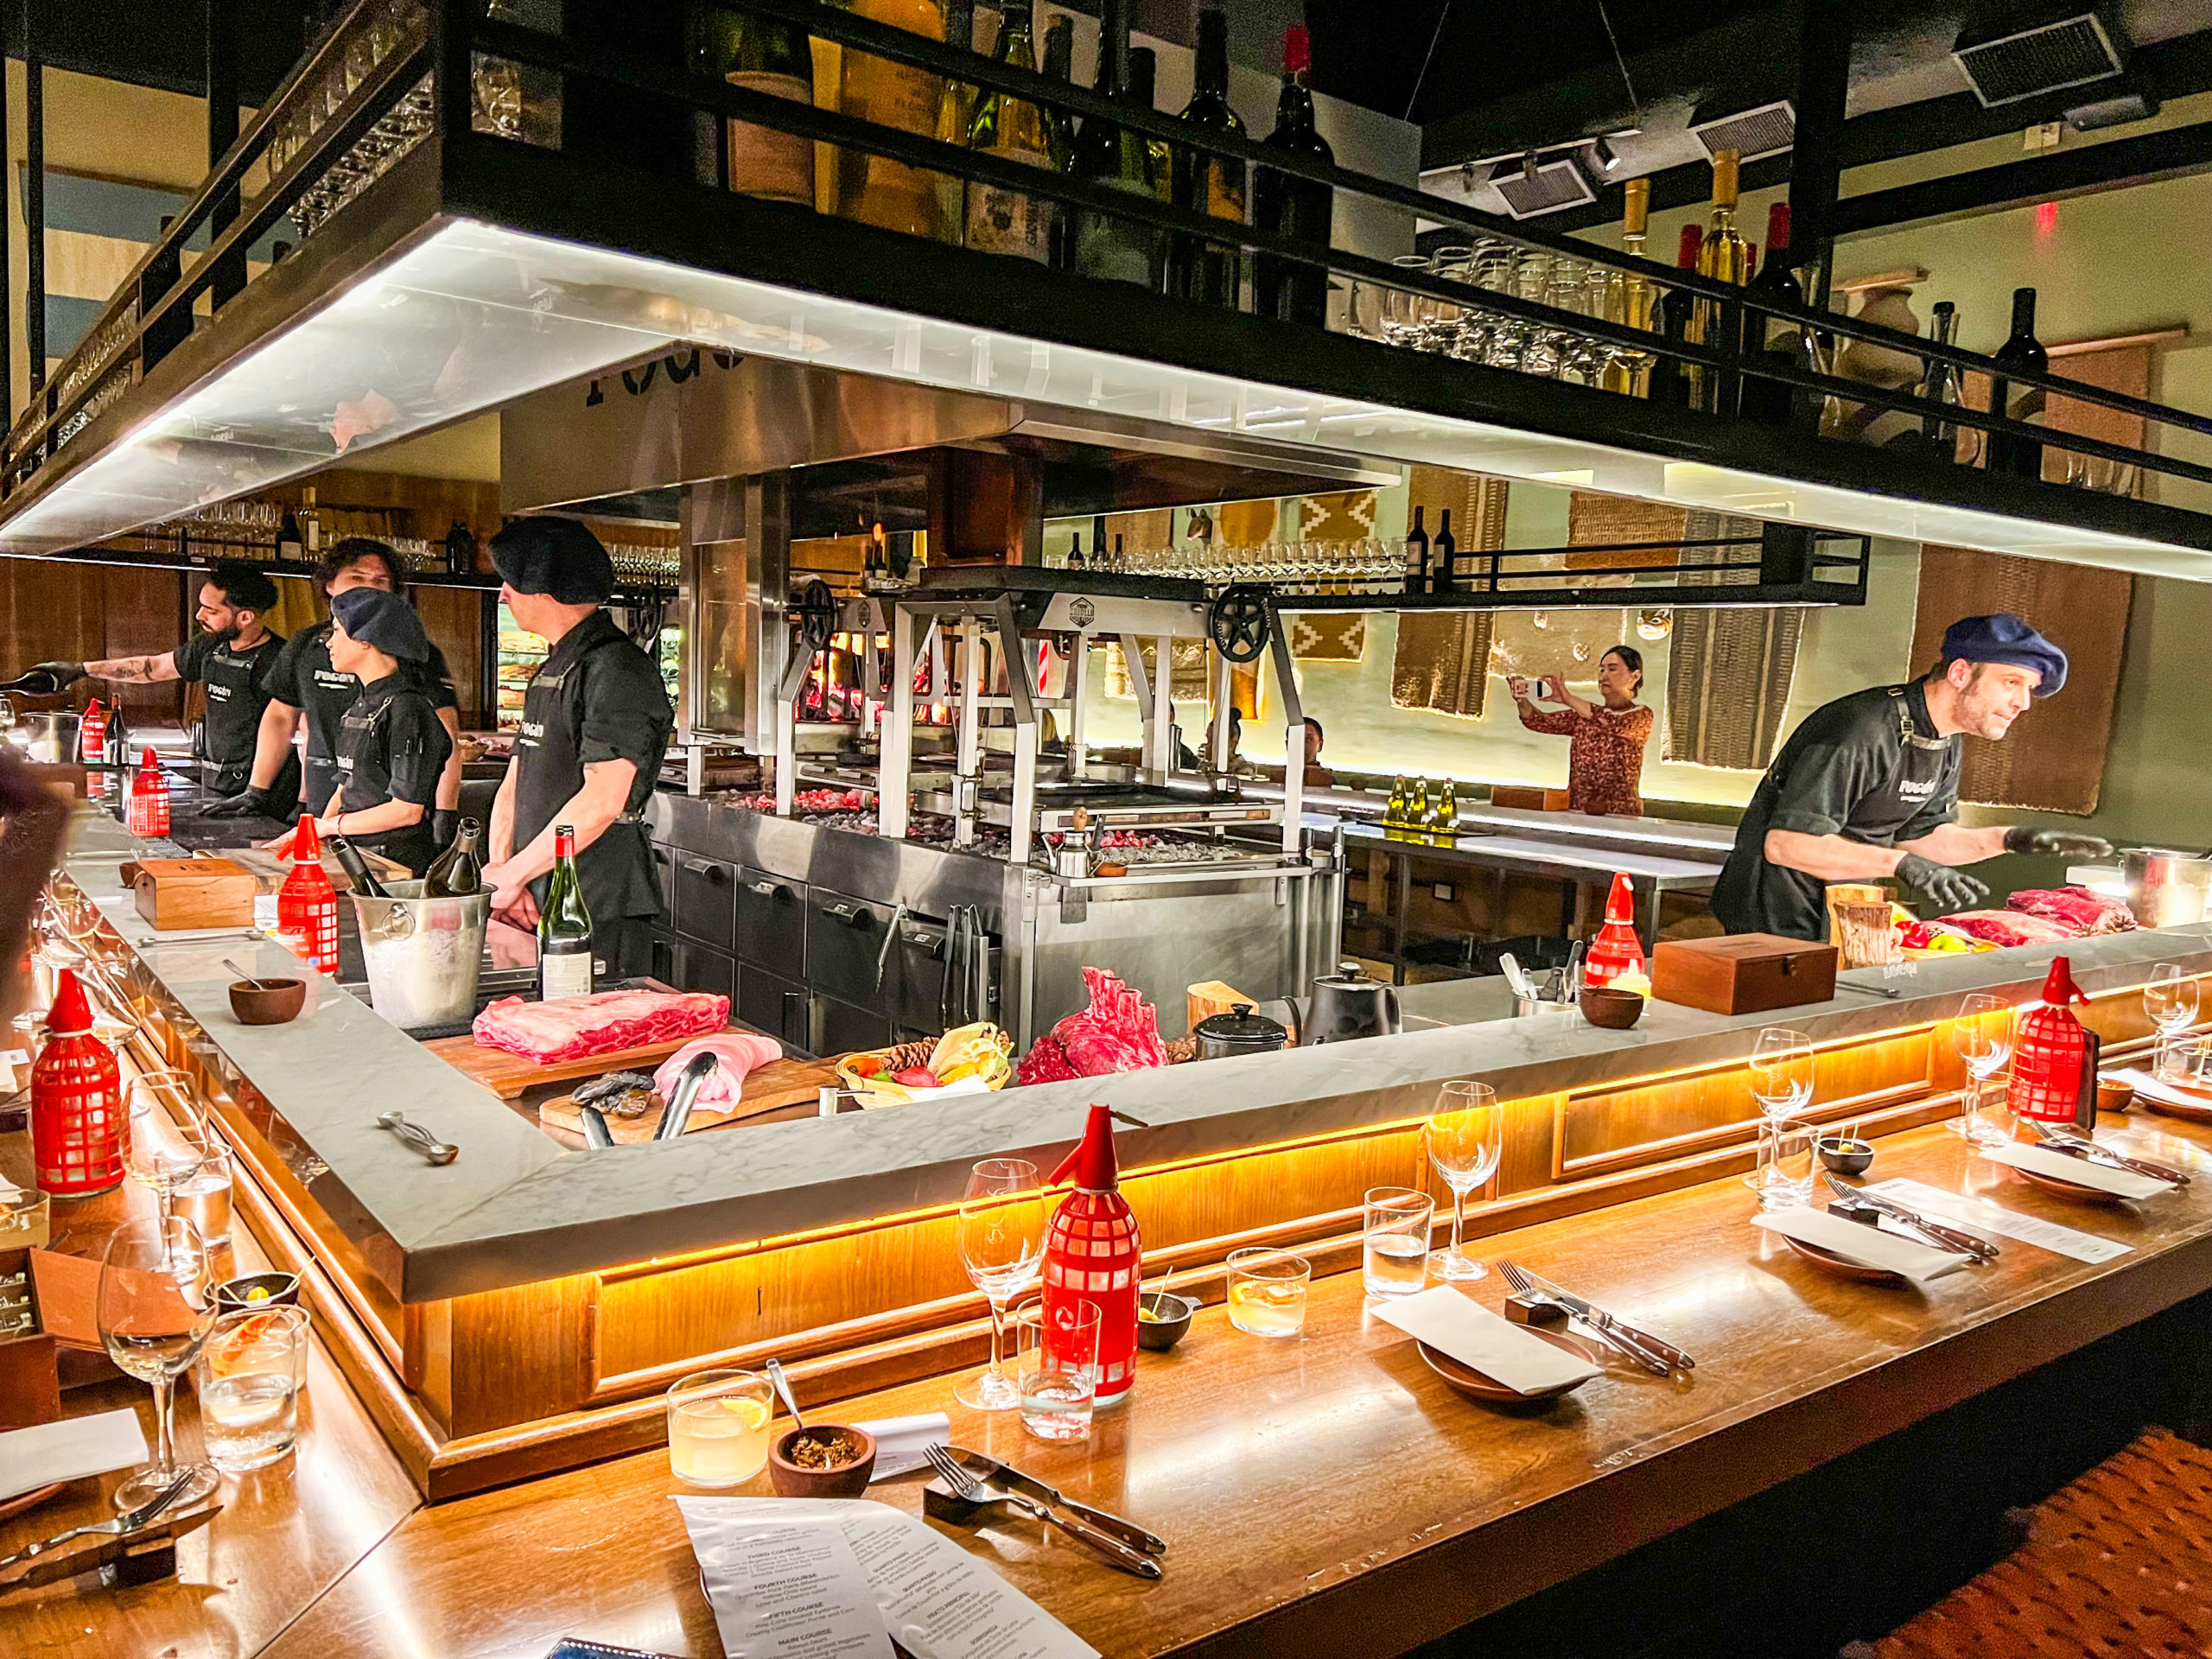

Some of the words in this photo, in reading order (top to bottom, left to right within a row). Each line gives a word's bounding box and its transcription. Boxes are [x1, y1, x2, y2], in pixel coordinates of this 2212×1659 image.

[770, 1546, 801, 1555] COURSE
[753, 1579, 785, 1590] FOURTH
[785, 1572, 817, 1583] COURSE
[791, 1601, 824, 1613] COURSE
[777, 1636, 799, 1645] MAIN
[799, 1627, 833, 1640] COURSE
